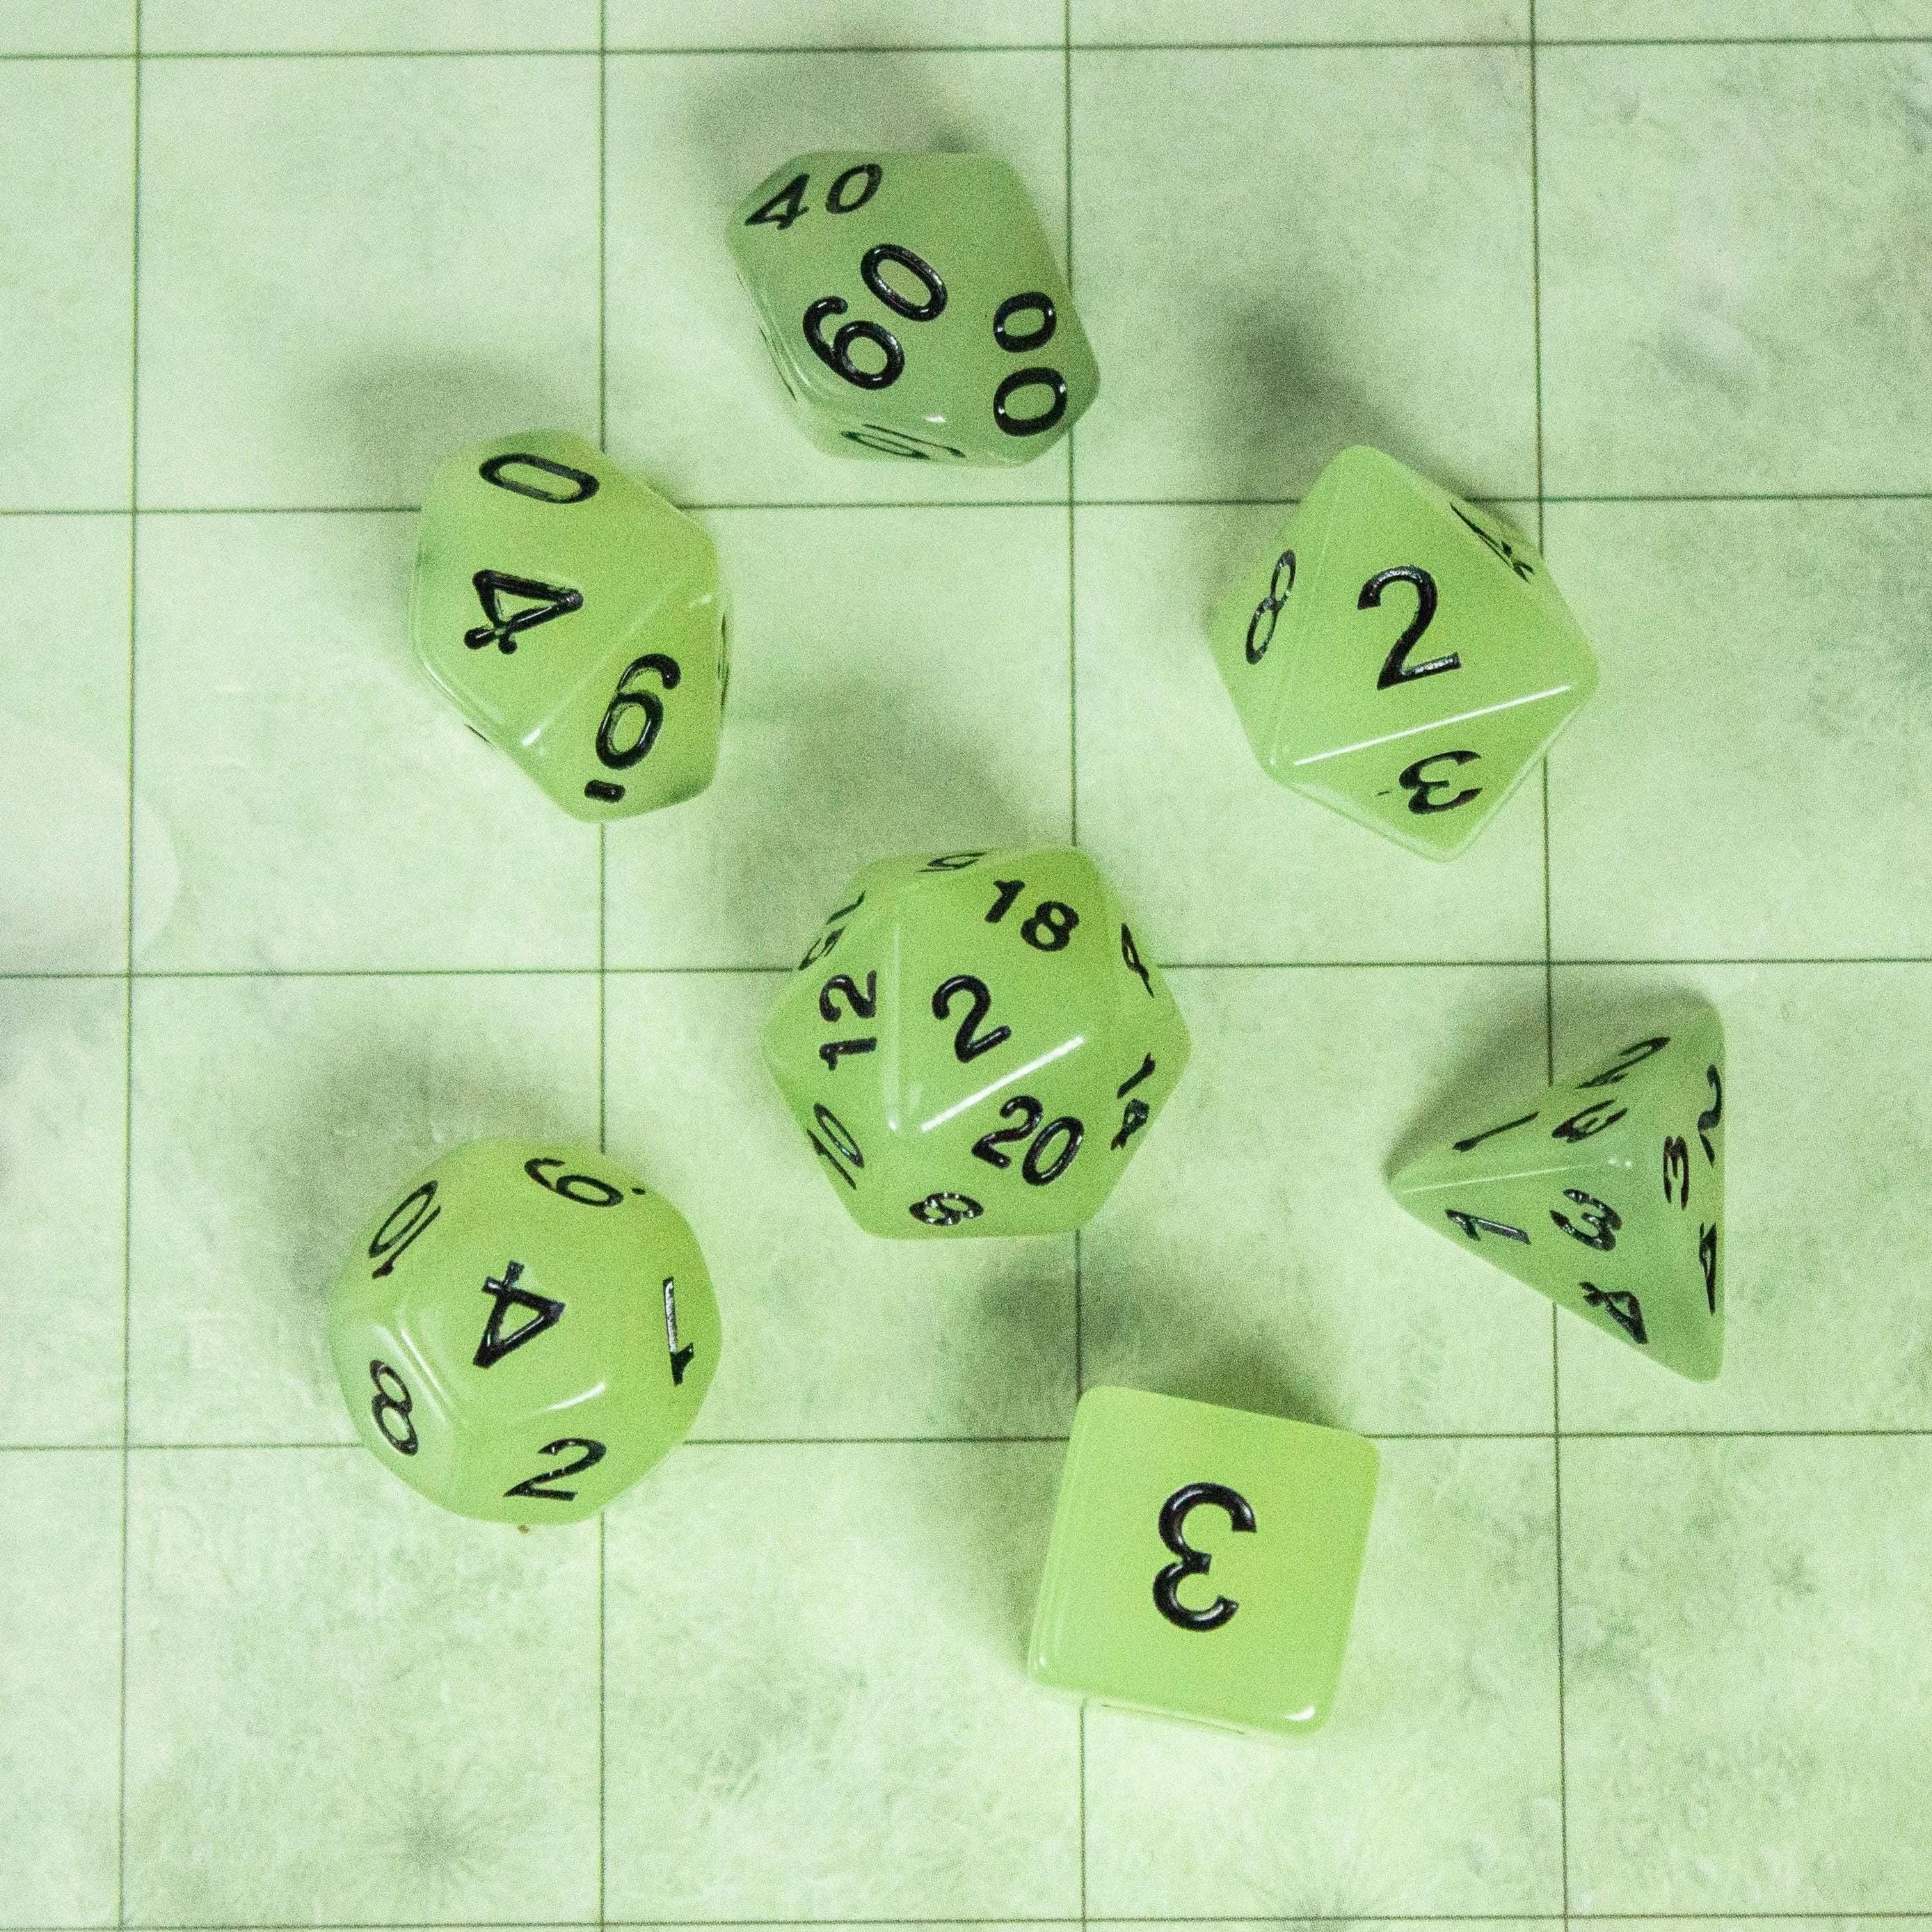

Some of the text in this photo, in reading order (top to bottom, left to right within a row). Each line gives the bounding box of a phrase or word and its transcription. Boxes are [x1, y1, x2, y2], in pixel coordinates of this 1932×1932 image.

[744, 162, 884, 231] 40
[801, 243, 949, 391] 60
[992, 290, 1069, 438] 00
[479, 452, 600, 504] 0
[463, 568, 584, 655] 4
[1245, 549, 1296, 665] 8
[1357, 565, 1462, 691] 2
[1398, 749, 1483, 815] 3
[984, 879, 1080, 952] 18
[818, 971, 877, 1071] 12
[931, 974, 1012, 1064] 2
[971, 1095, 1085, 1187] 20
[1111, 1051, 1157, 1151] 14
[1551, 1099, 1629, 1143] 3
[806, 1103, 865, 1190] 10
[1663, 1135, 1690, 1210] 3
[369, 1180, 441, 1280] 10
[1445, 1208, 1531, 1245] 1
[1549, 1188, 1623, 1252] 3
[472, 1260, 566, 1370] 4
[662, 1276, 695, 1387] 1
[1578, 1281, 1649, 1345] 4
[369, 1359, 419, 1456] 8
[502, 1436, 607, 1501] 2
[1152, 1482, 1257, 1632] 3
